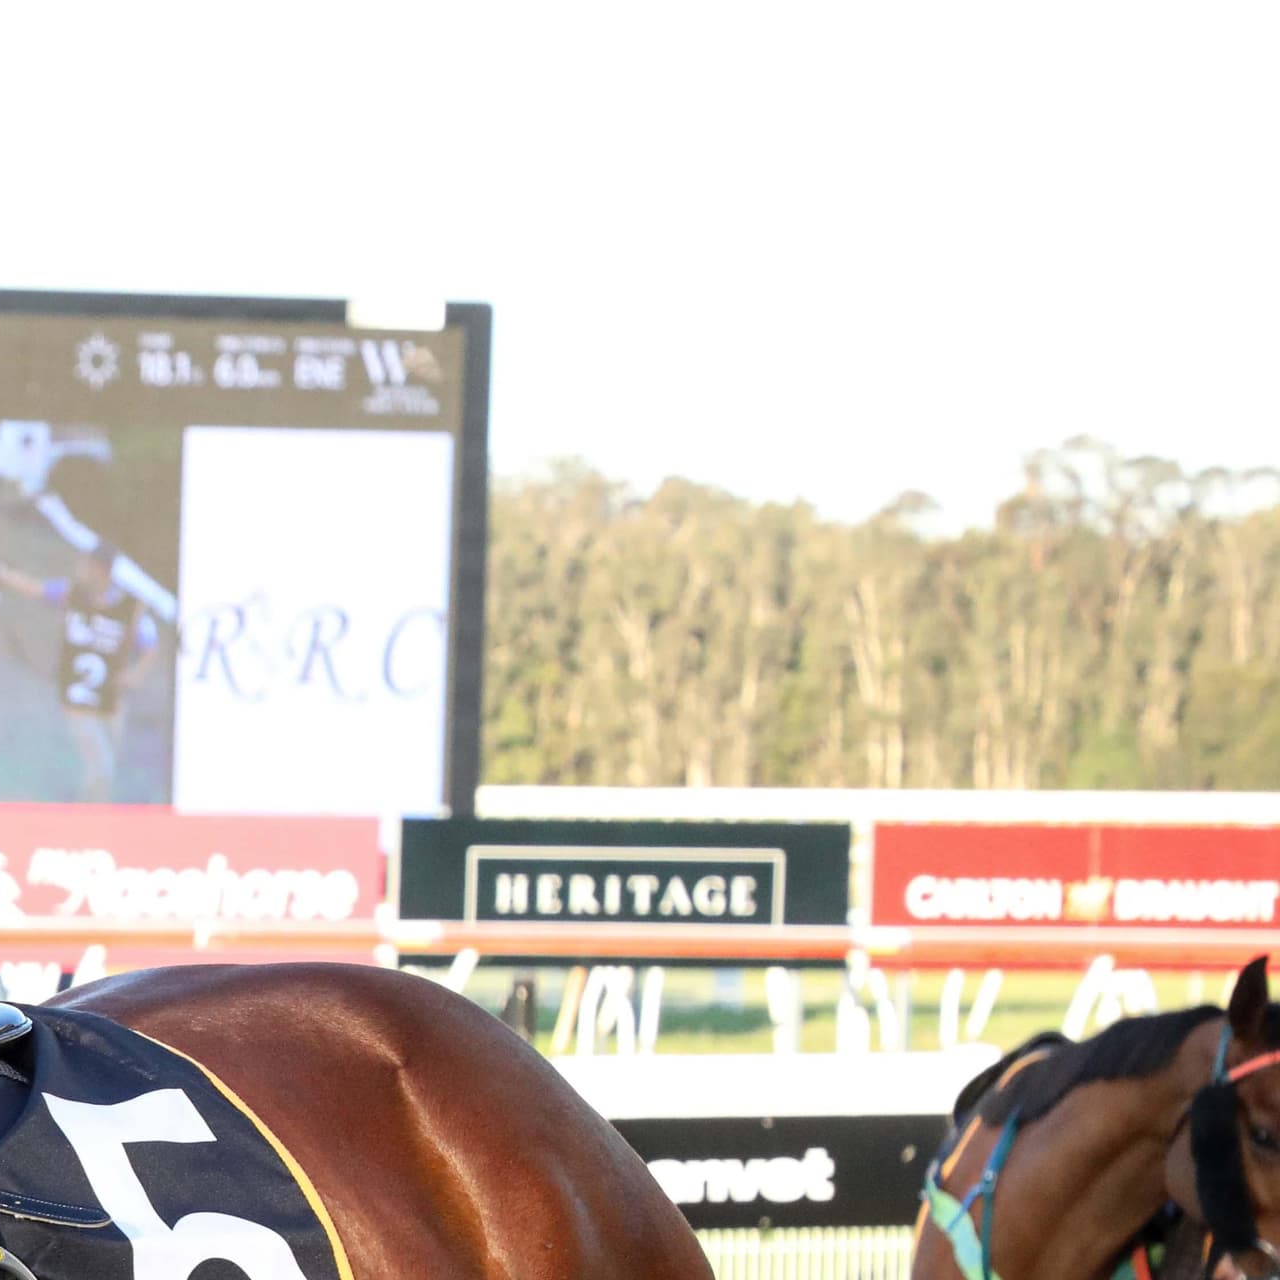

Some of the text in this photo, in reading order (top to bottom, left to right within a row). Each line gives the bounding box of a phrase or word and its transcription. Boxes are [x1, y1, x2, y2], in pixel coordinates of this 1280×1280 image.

[495, 873, 757, 917] HERITAGE
[904, 873, 1279, 923] CARLTON DRAUGHT
